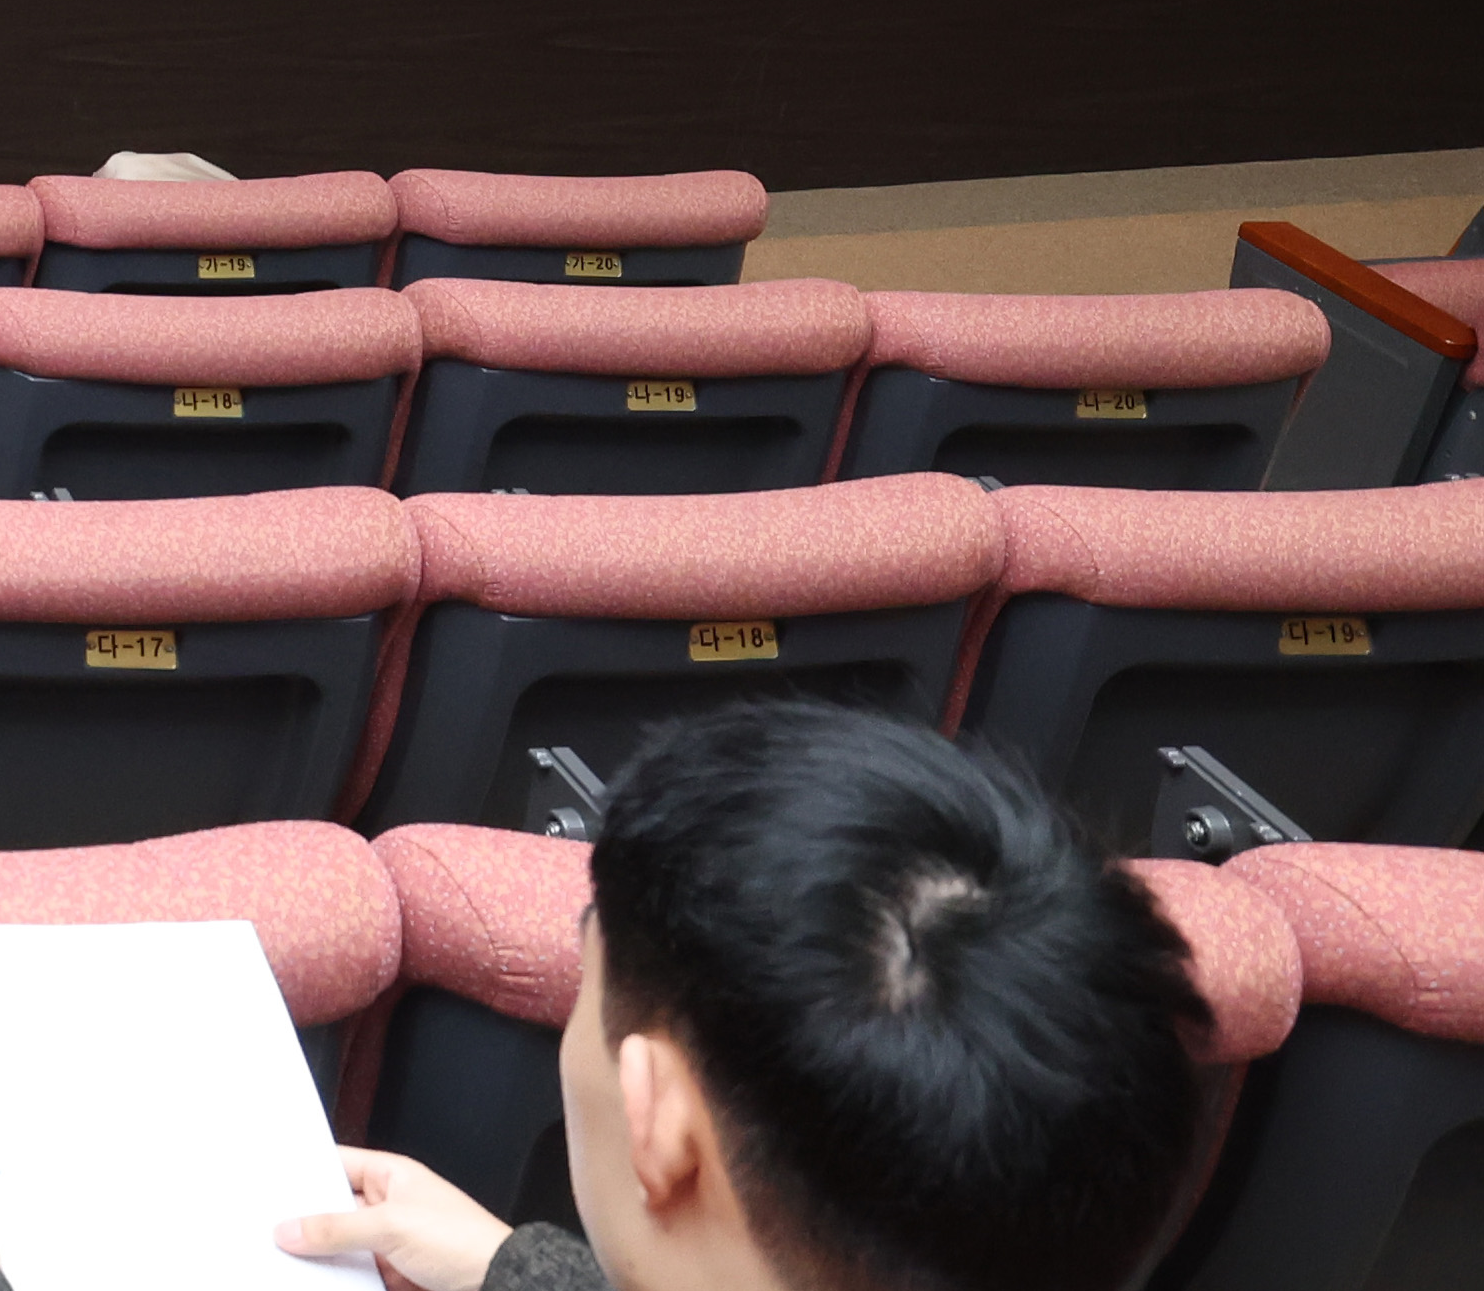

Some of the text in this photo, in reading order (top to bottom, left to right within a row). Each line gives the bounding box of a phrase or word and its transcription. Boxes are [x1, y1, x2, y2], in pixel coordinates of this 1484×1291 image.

[205, 257, 245, 271] 가-19
[572, 256, 613, 271] 가-20
[634, 382, 684, 402] 나-19
[1084, 391, 1135, 412] 나-20
[181, 393, 232, 412] 나-18
[699, 625, 765, 651] 다-18
[1287, 621, 1355, 646] 다-19
[97, 633, 162, 658] 다-17
